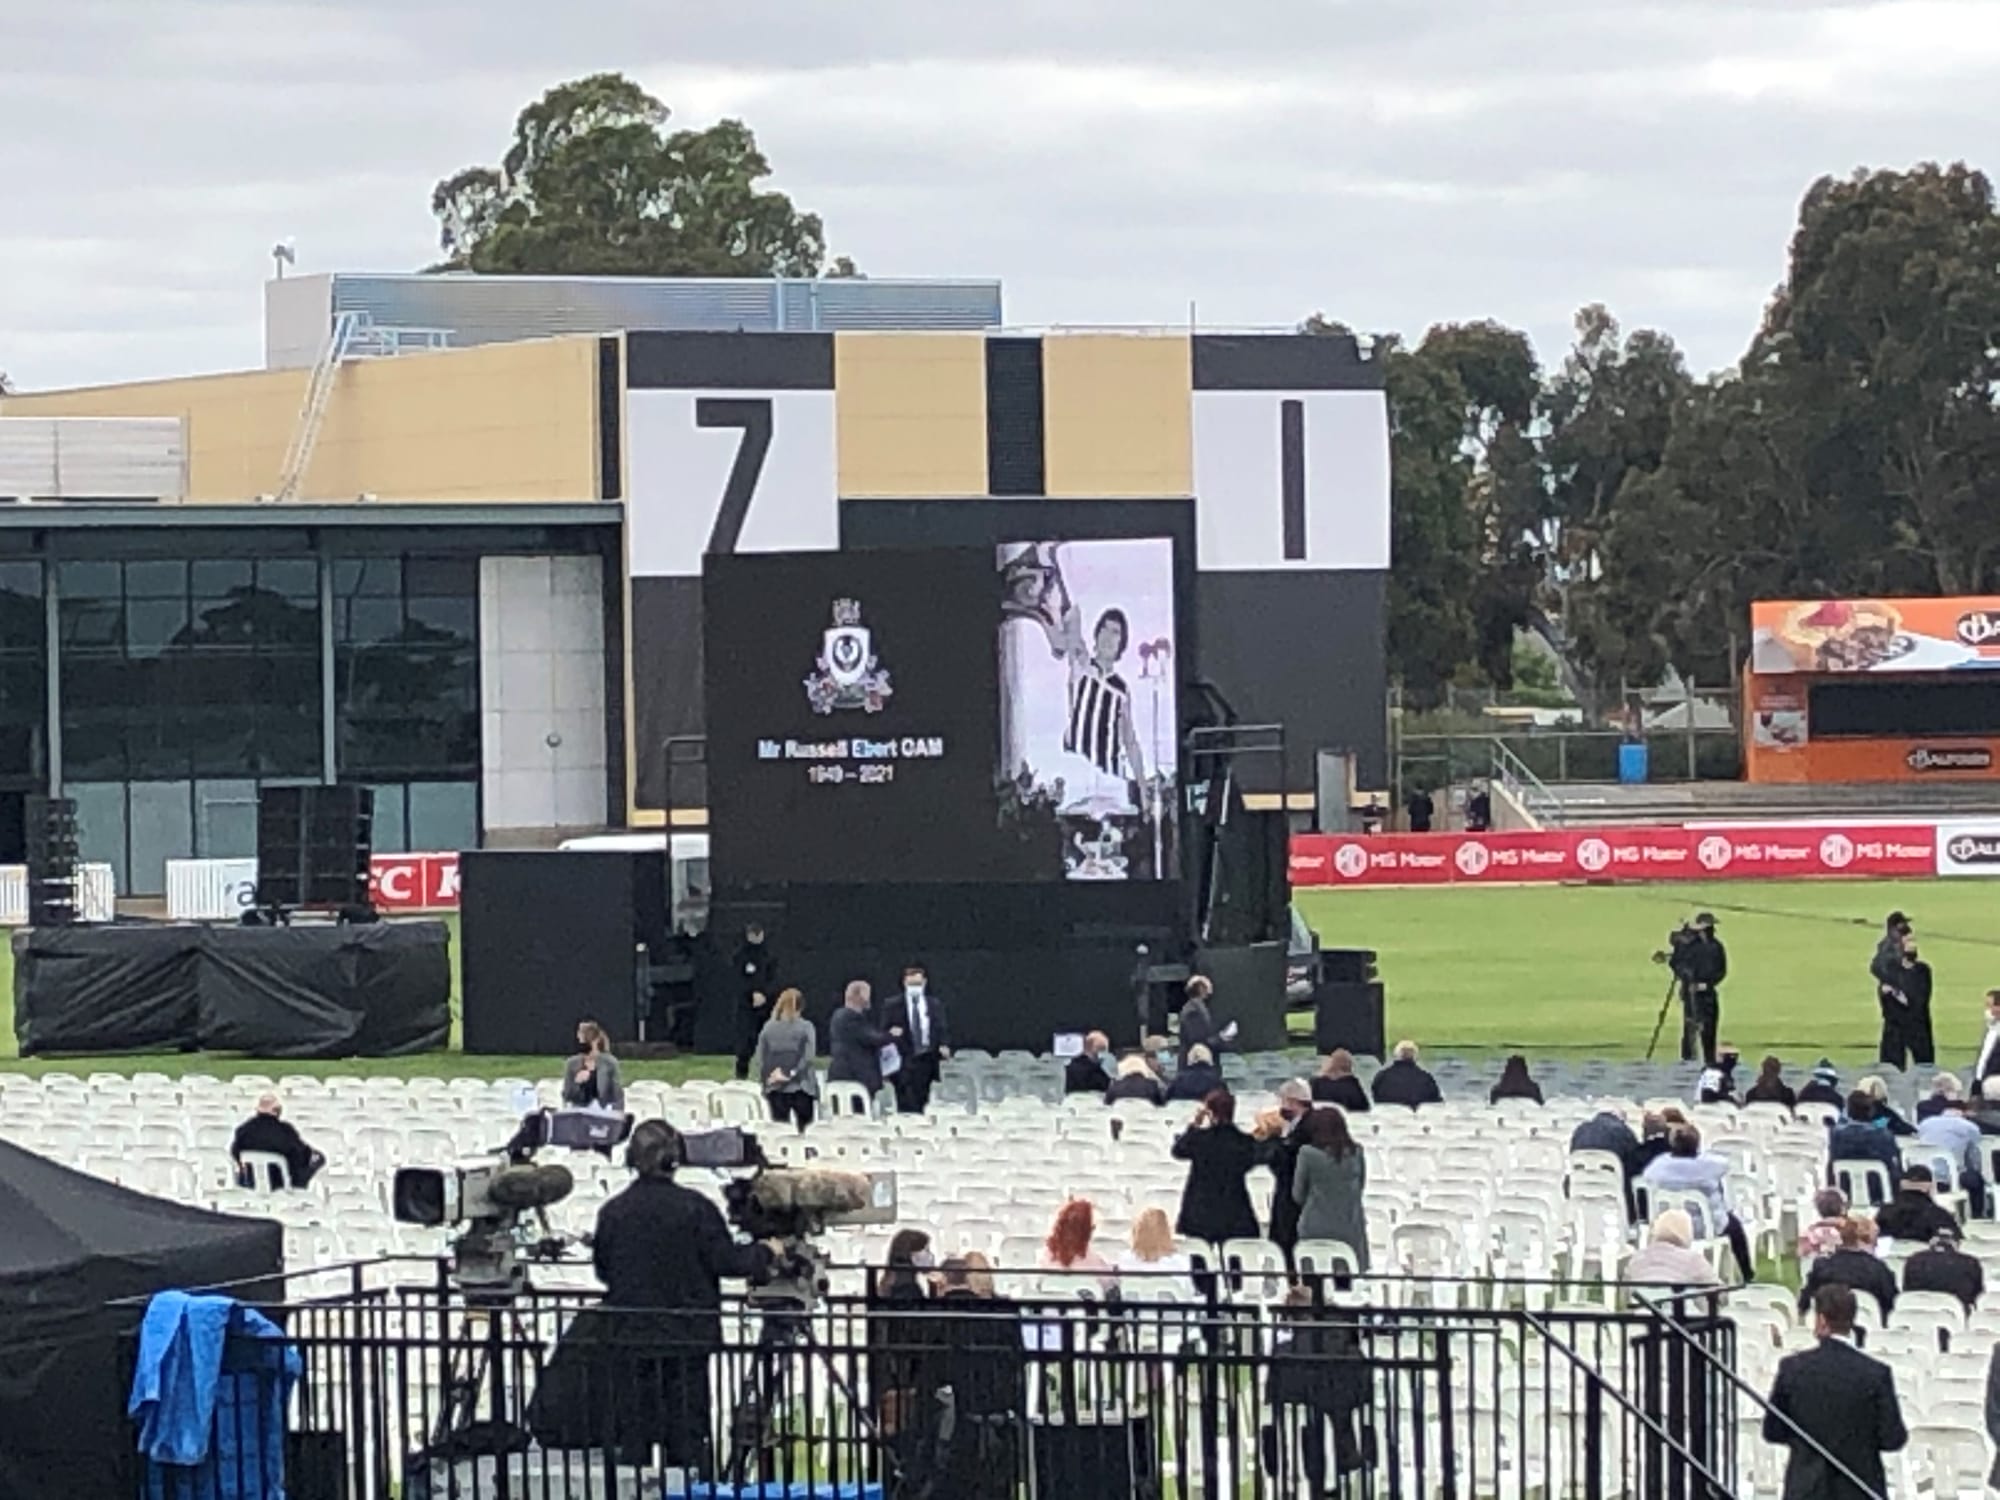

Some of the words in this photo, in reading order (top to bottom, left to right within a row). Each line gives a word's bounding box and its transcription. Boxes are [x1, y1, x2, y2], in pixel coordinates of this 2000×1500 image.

[696, 398, 774, 553] 7
[758, 738, 781, 759] Mr
[785, 738, 849, 758] Russell
[852, 737, 898, 758] Ebert
[901, 737, 943, 758] OAM
[859, 764, 894, 783] 2021
[1370, 851, 1397, 867] MG
[1400, 852, 1446, 867] Motor
[1491, 849, 1518, 865] MG
[1521, 849, 1566, 864] Motor
[1613, 846, 1640, 862] MG
[1643, 846, 1688, 861] Motor
[1735, 844, 1761, 861] MG
[1765, 844, 1811, 861] Motor
[1856, 842, 1883, 859] MG
[1886, 842, 1932, 858] Motor
